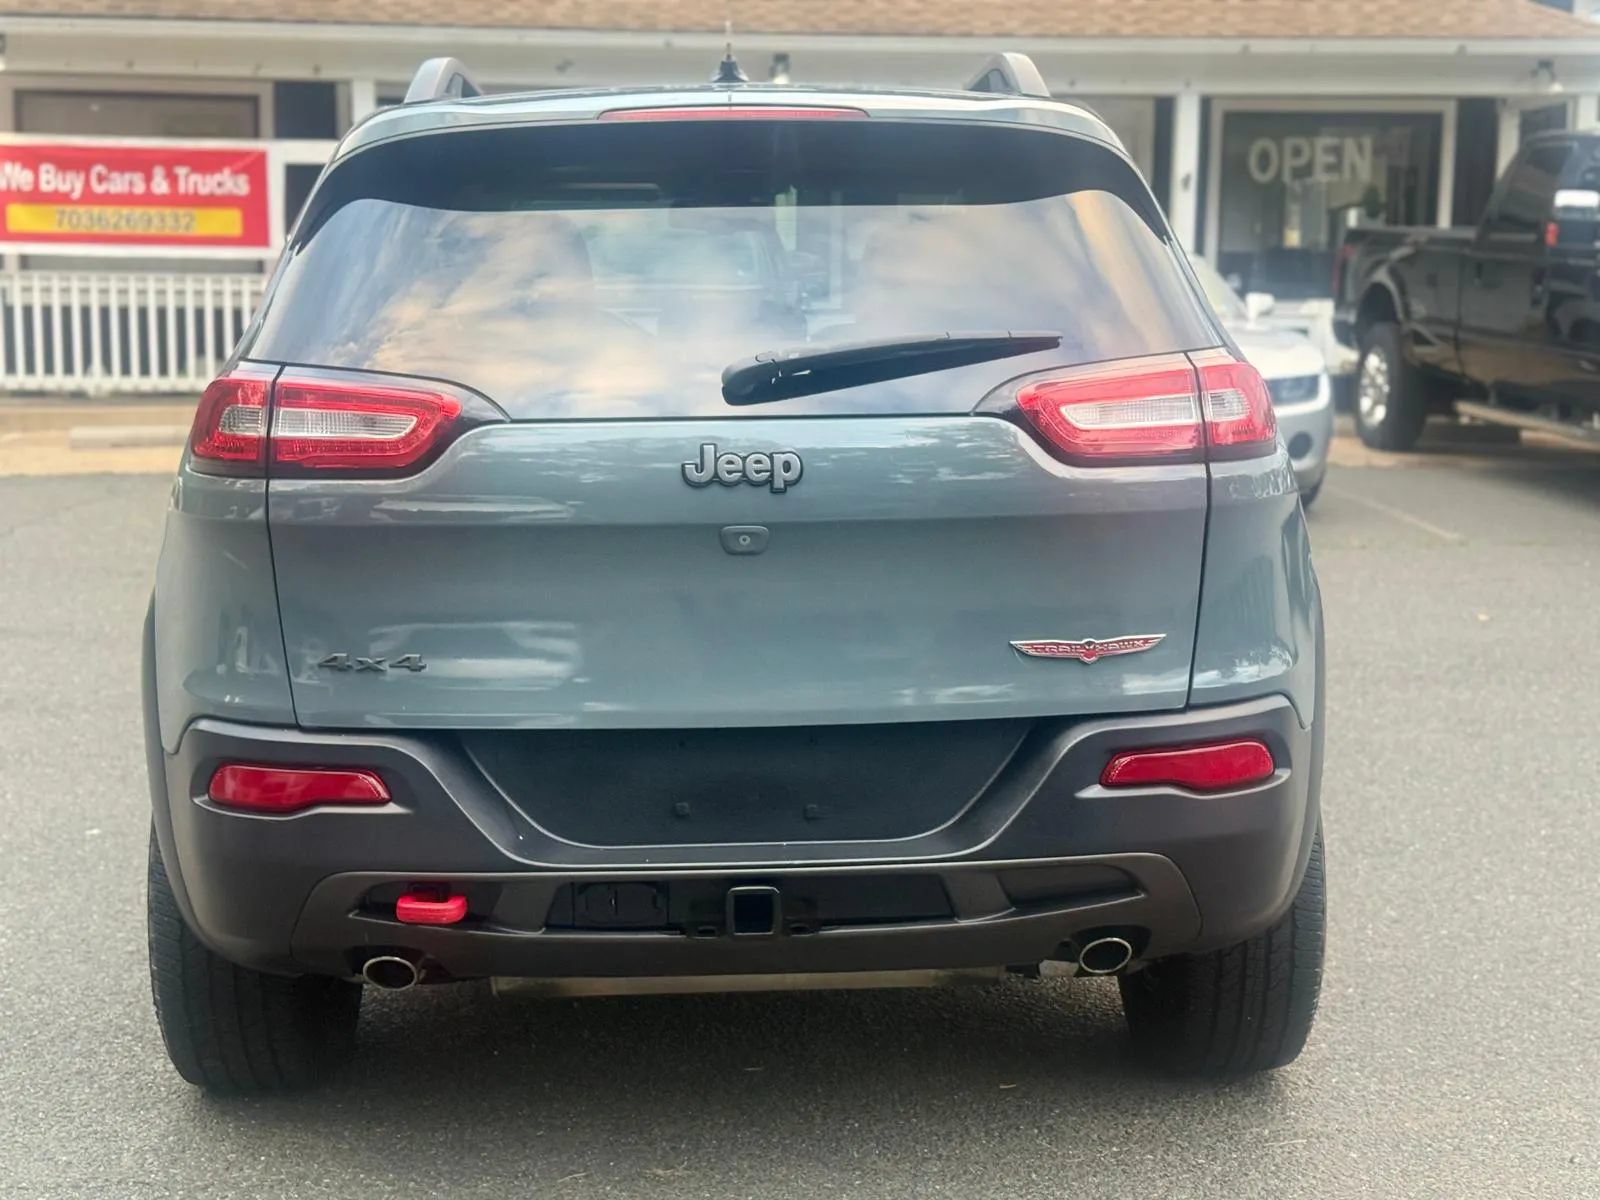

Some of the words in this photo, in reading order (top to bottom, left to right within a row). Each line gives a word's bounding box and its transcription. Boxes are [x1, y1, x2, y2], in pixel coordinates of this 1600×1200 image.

[0, 161, 34, 192] We
[38, 163, 85, 200] Buy
[90, 164, 146, 194] Cars
[150, 166, 170, 195] &
[174, 166, 249, 196] Trucks
[1248, 136, 1373, 183] OPEN
[681, 443, 803, 493] Jeep
[318, 652, 427, 672] 4x4
